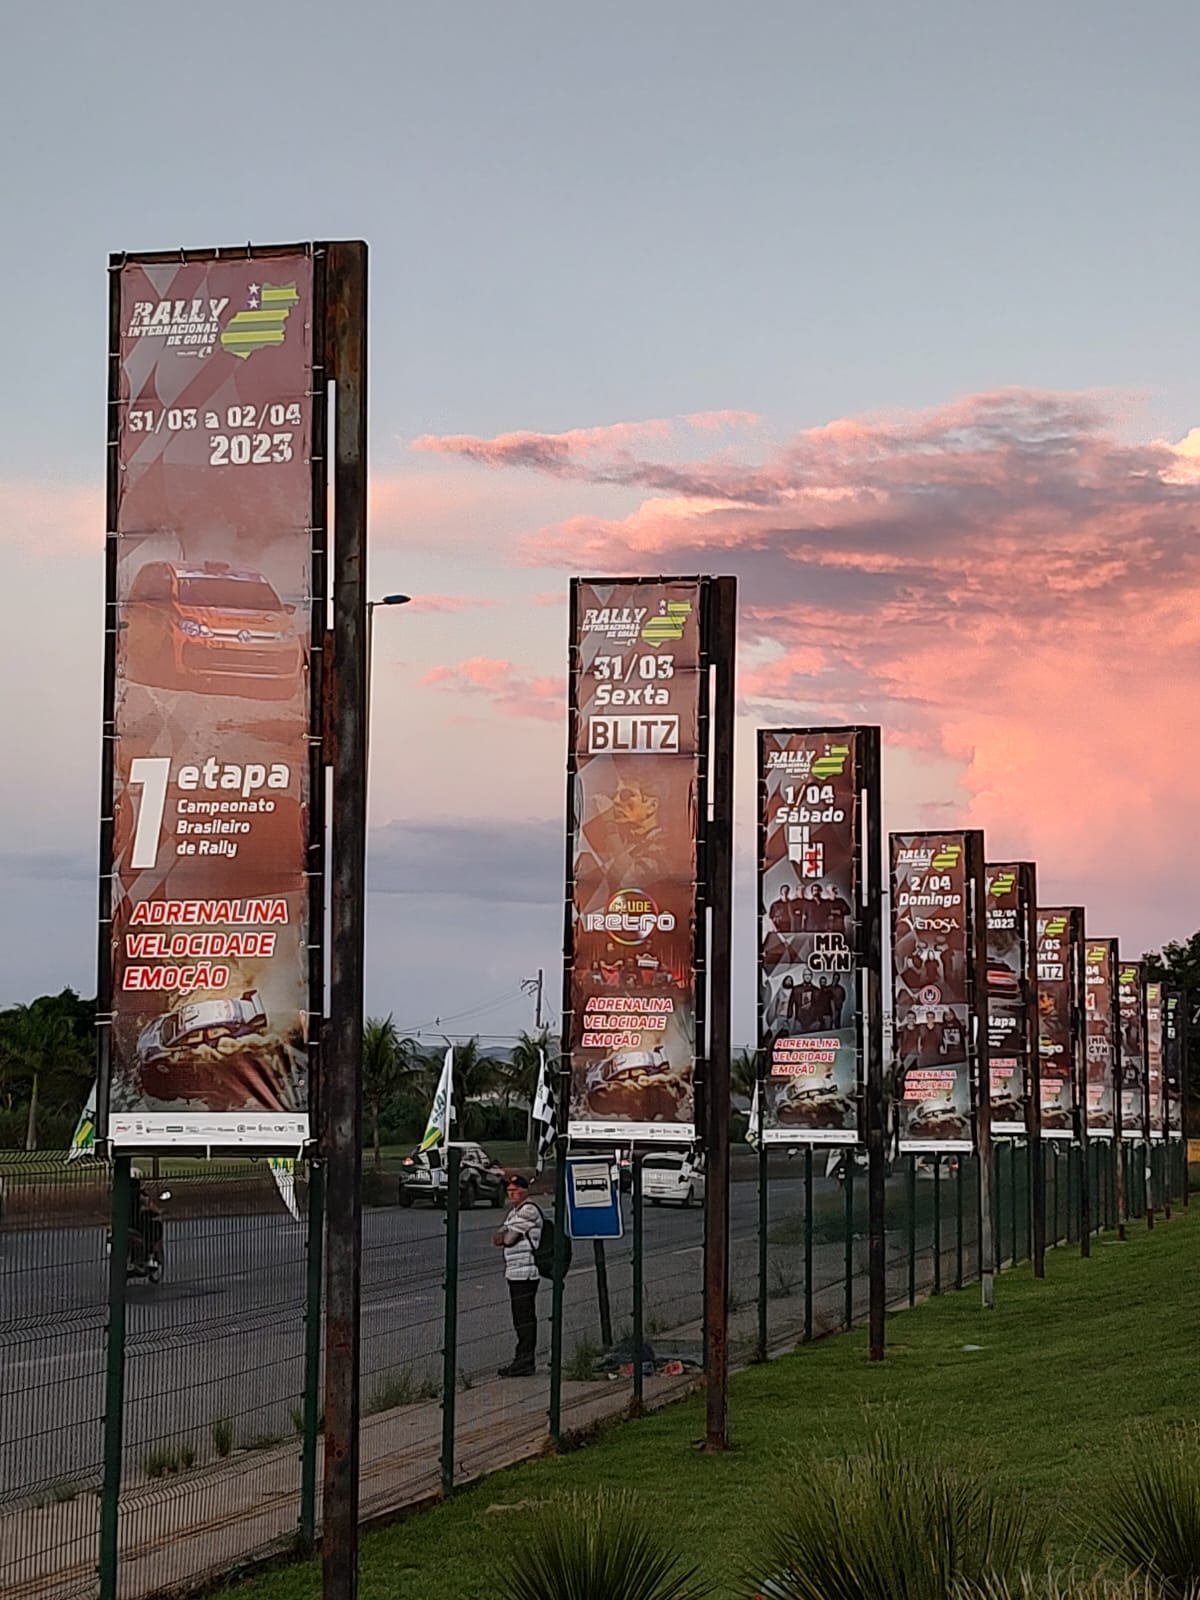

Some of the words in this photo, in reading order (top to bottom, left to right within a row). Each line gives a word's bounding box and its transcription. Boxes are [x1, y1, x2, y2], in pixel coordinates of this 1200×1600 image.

[130, 298, 229, 326] RALLY
[127, 322, 219, 338] INTERNACIONAL
[166, 335, 182, 346] DE
[129, 408, 197, 434] 31/03
[204, 411, 219, 429] a
[227, 403, 301, 430] 02/04
[209, 433, 293, 465] 2023
[583, 607, 647, 624] RALLY
[594, 654, 674, 684] 31/03
[594, 684, 669, 705] Sexta
[591, 720, 677, 750] BLITZ
[768, 750, 816, 764] RALLY
[785, 784, 835, 806] 1/04
[130, 757, 171, 869] 1
[177, 757, 290, 797] etapa
[177, 799, 275, 816] Campeonato
[775, 805, 845, 824] Sábado
[176, 820, 250, 834] Brasileiro
[177, 841, 195, 855] de
[198, 841, 237, 858] Rally
[911, 875, 951, 893] 2/04
[899, 893, 961, 908] Domingo
[129, 900, 288, 925] ADRENALINA
[987, 918, 1015, 929] 2023
[126, 932, 276, 958] VELOCIDADE
[808, 953, 851, 972] GYN
[122, 961, 229, 995] EMOÇÃO
[585, 997, 674, 1012] ADRENALINA
[583, 1014, 667, 1030] VELOCIDADE
[582, 1031, 641, 1050] EMOÇÃO
[774, 1038, 840, 1049] ADRENALINA
[772, 1051, 836, 1063] VELOCIDADE
